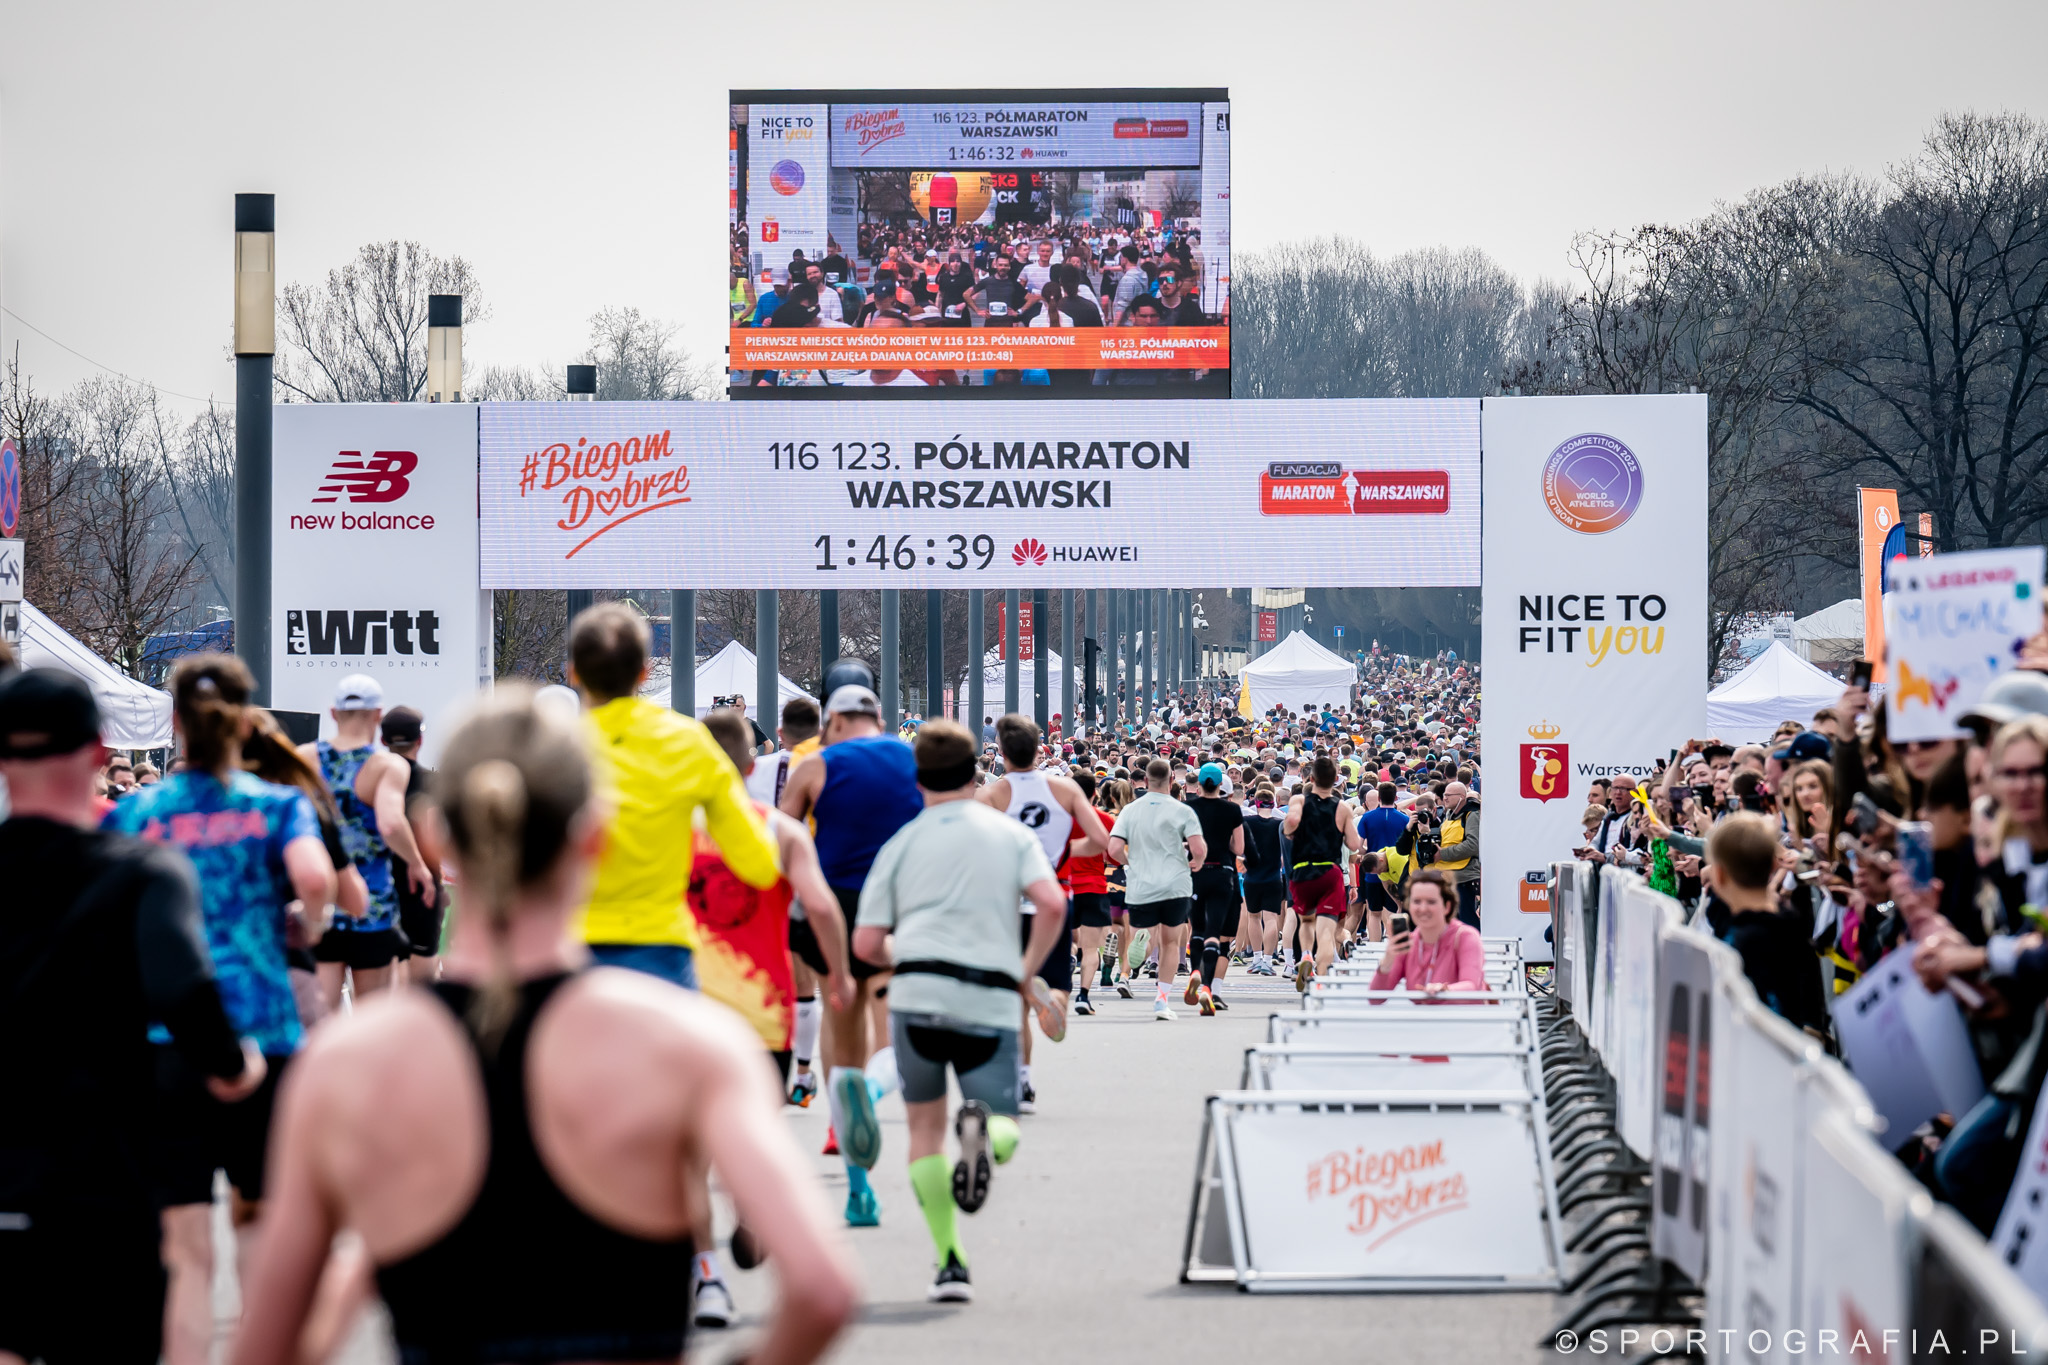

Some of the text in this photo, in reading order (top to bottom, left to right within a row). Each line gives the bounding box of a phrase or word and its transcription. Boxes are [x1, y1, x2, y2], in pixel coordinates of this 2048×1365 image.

[761, 118, 813, 128] NICE TO
[844, 108, 900, 133] #Biegam
[933, 109, 1088, 124] 116 123. PÓŁMARATON
[761, 129, 813, 145] FIT you
[960, 126, 1058, 138] WARSZAWSKI
[949, 146, 1068, 160] 1:46:32 HUAWEI
[745, 334, 1076, 346] PIERWSZE MIEJSCE WŚRÓD KOBIET W 116 123. PÓŁMARATONIE
[1100, 336, 1218, 348] 116 123. PÓŁMARATON
[745, 351, 1013, 362] WARSZAWSKIM ZAJĘŁA DAIANA OCAMPO (1:10:48)
[1100, 350, 1174, 360] WARSZAWSKI
[768, 434, 1190, 470] 116 123. PÓŁMARATON
[1562, 436, 1621, 454] COMPETITION
[519, 430, 674, 498] #Biegam
[1620, 450, 1638, 472] 2025
[1273, 465, 1338, 476] FUNDACJA
[1546, 453, 1563, 498] RANKINGS
[846, 480, 1111, 508] WARSZAWSKI
[1272, 485, 1444, 500] MARATON WARSZAWSKI
[1576, 492, 1608, 500] WORLD
[1550, 498, 1574, 526] WORLD
[1568, 500, 1614, 508] ATHLETICS
[290, 510, 434, 530] new balance
[814, 534, 1138, 571] 1:46:39 HUAWEI
[1520, 594, 1666, 622] NICE TO
[306, 610, 440, 654] Witt
[1520, 626, 1665, 668] FIT you
[287, 660, 440, 668] ISOTONIC DRINK
[1577, 763, 1656, 776] Warszaw
[1306, 1139, 1446, 1201] #Biegam
